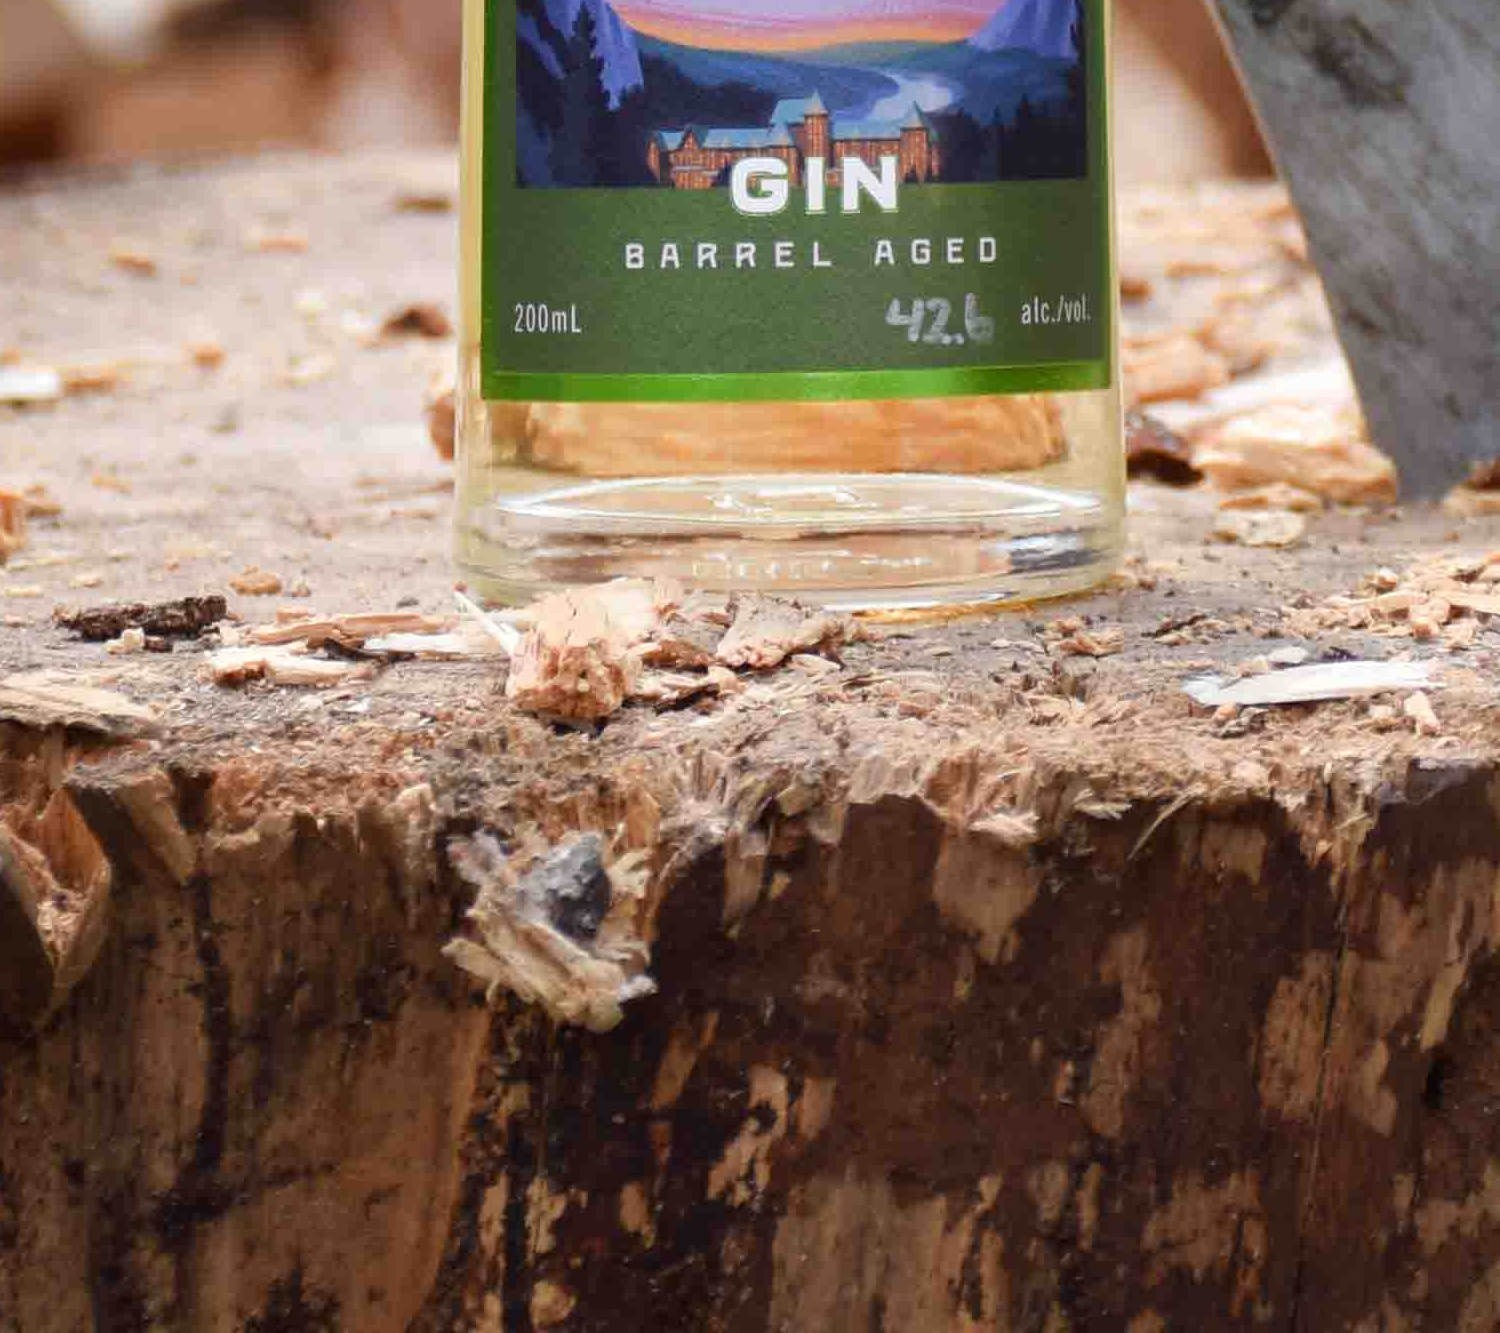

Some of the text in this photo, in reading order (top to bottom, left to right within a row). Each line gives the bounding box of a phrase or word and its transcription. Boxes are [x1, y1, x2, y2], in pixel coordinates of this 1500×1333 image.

[730, 156, 900, 215] GIN
[625, 236, 998, 270] BARREL AGED
[513, 303, 582, 335] 200mL
[1020, 293, 1092, 325] alc./vol.
